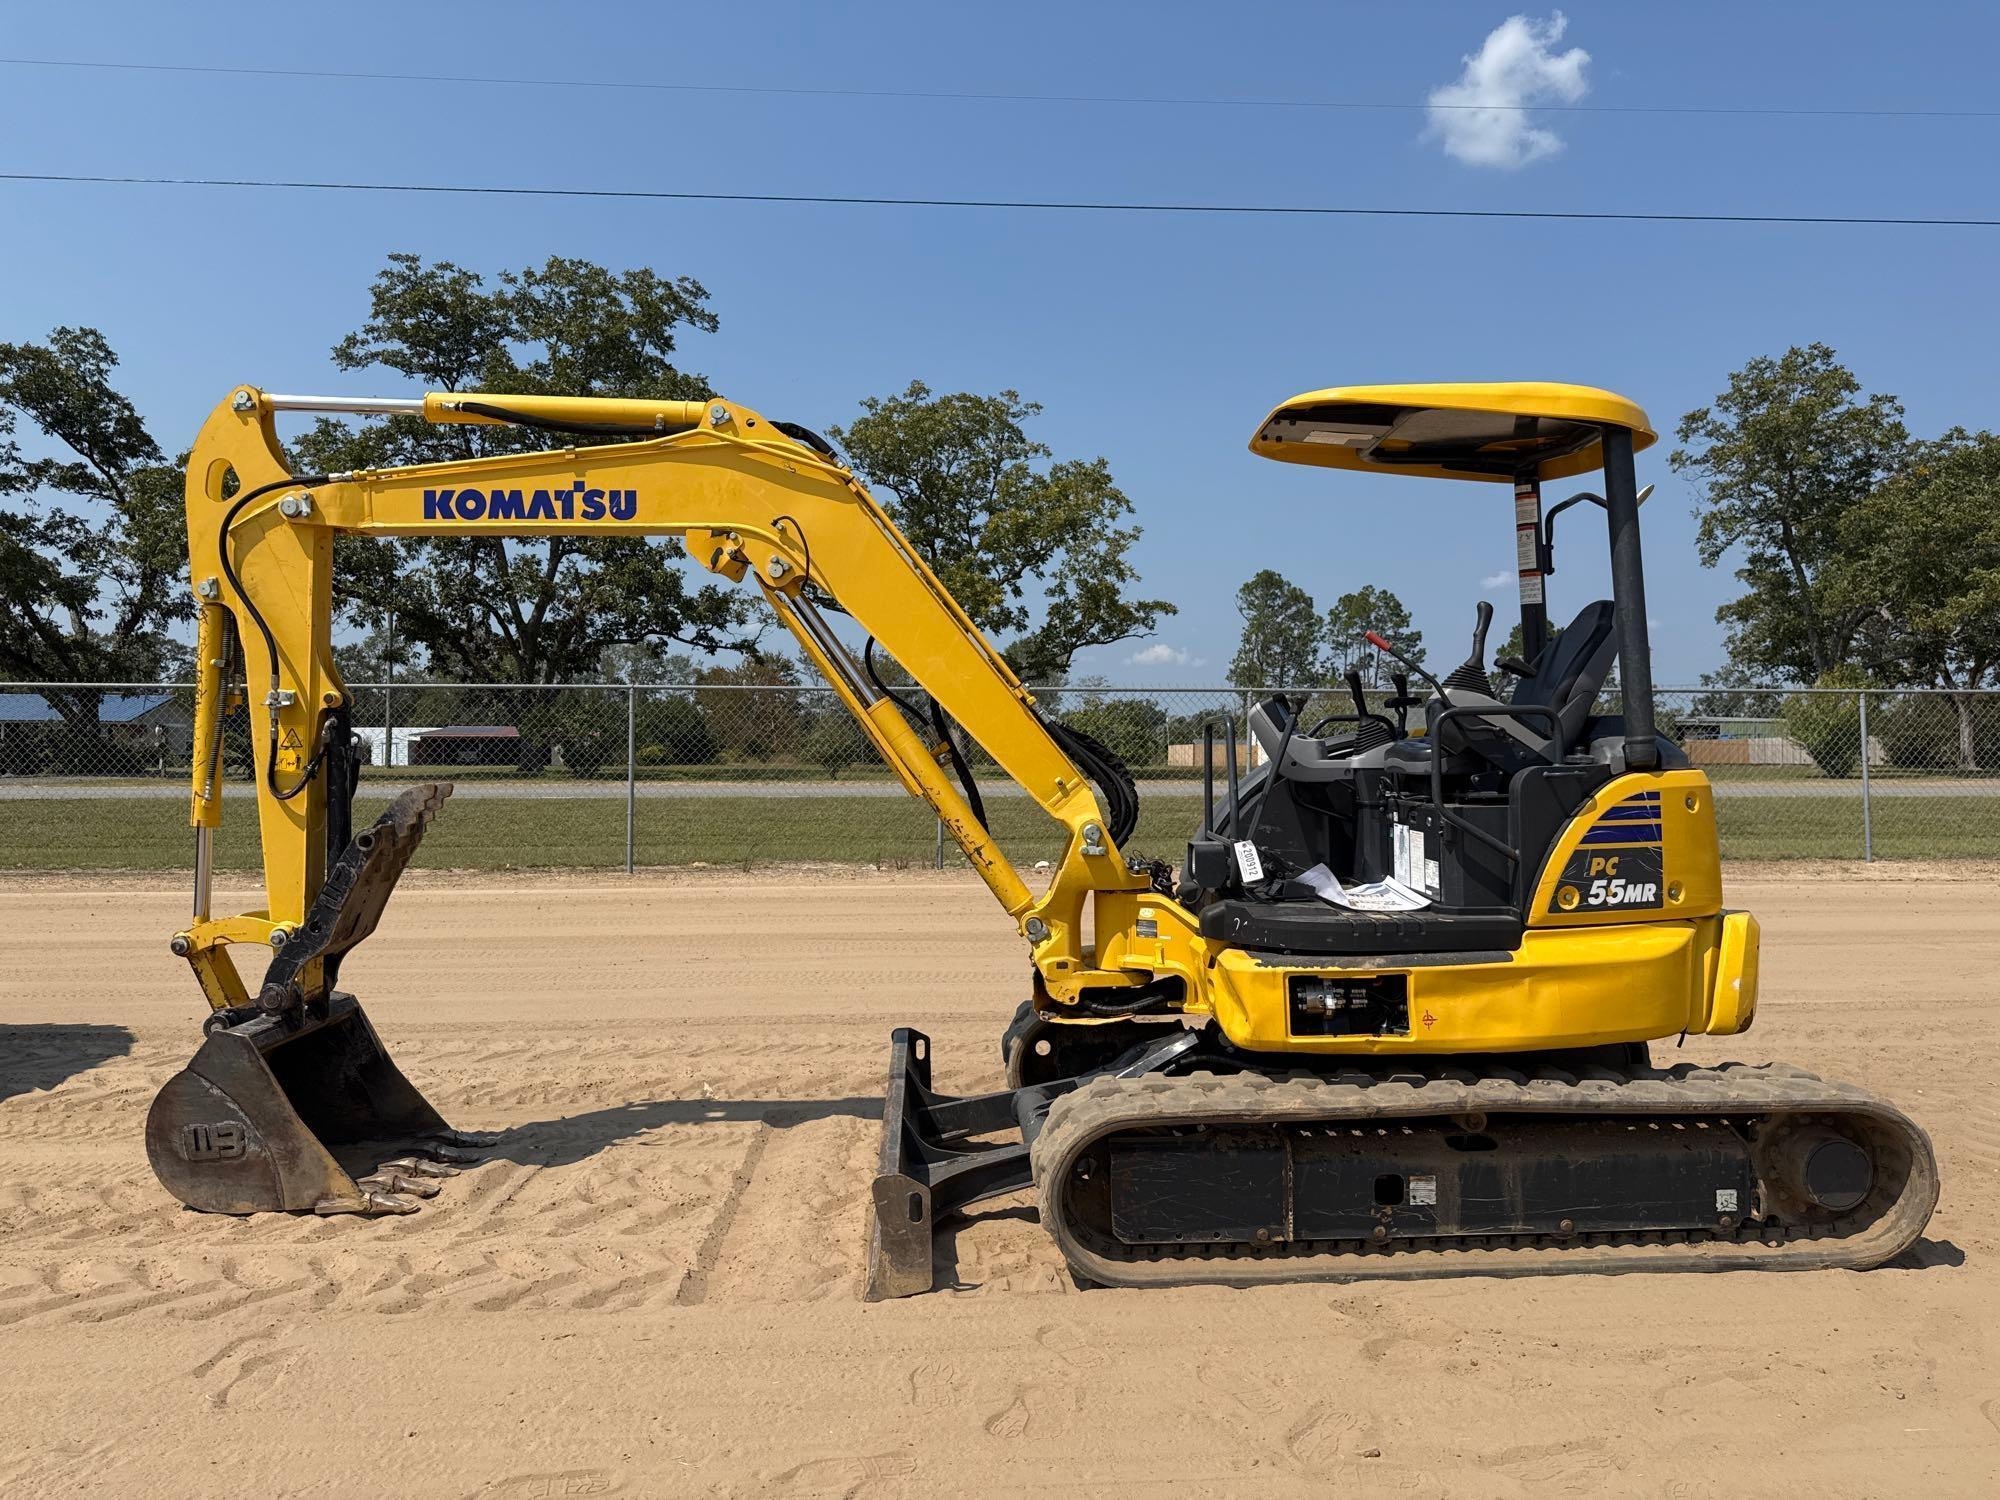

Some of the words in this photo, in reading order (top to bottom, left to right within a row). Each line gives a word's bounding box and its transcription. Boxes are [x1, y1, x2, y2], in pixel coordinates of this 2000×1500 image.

[423, 480, 638, 521] KOMATSU
[1243, 848, 1259, 876] 200912
[1589, 856, 1619, 876] PC
[1587, 878, 1657, 905] 55MR
